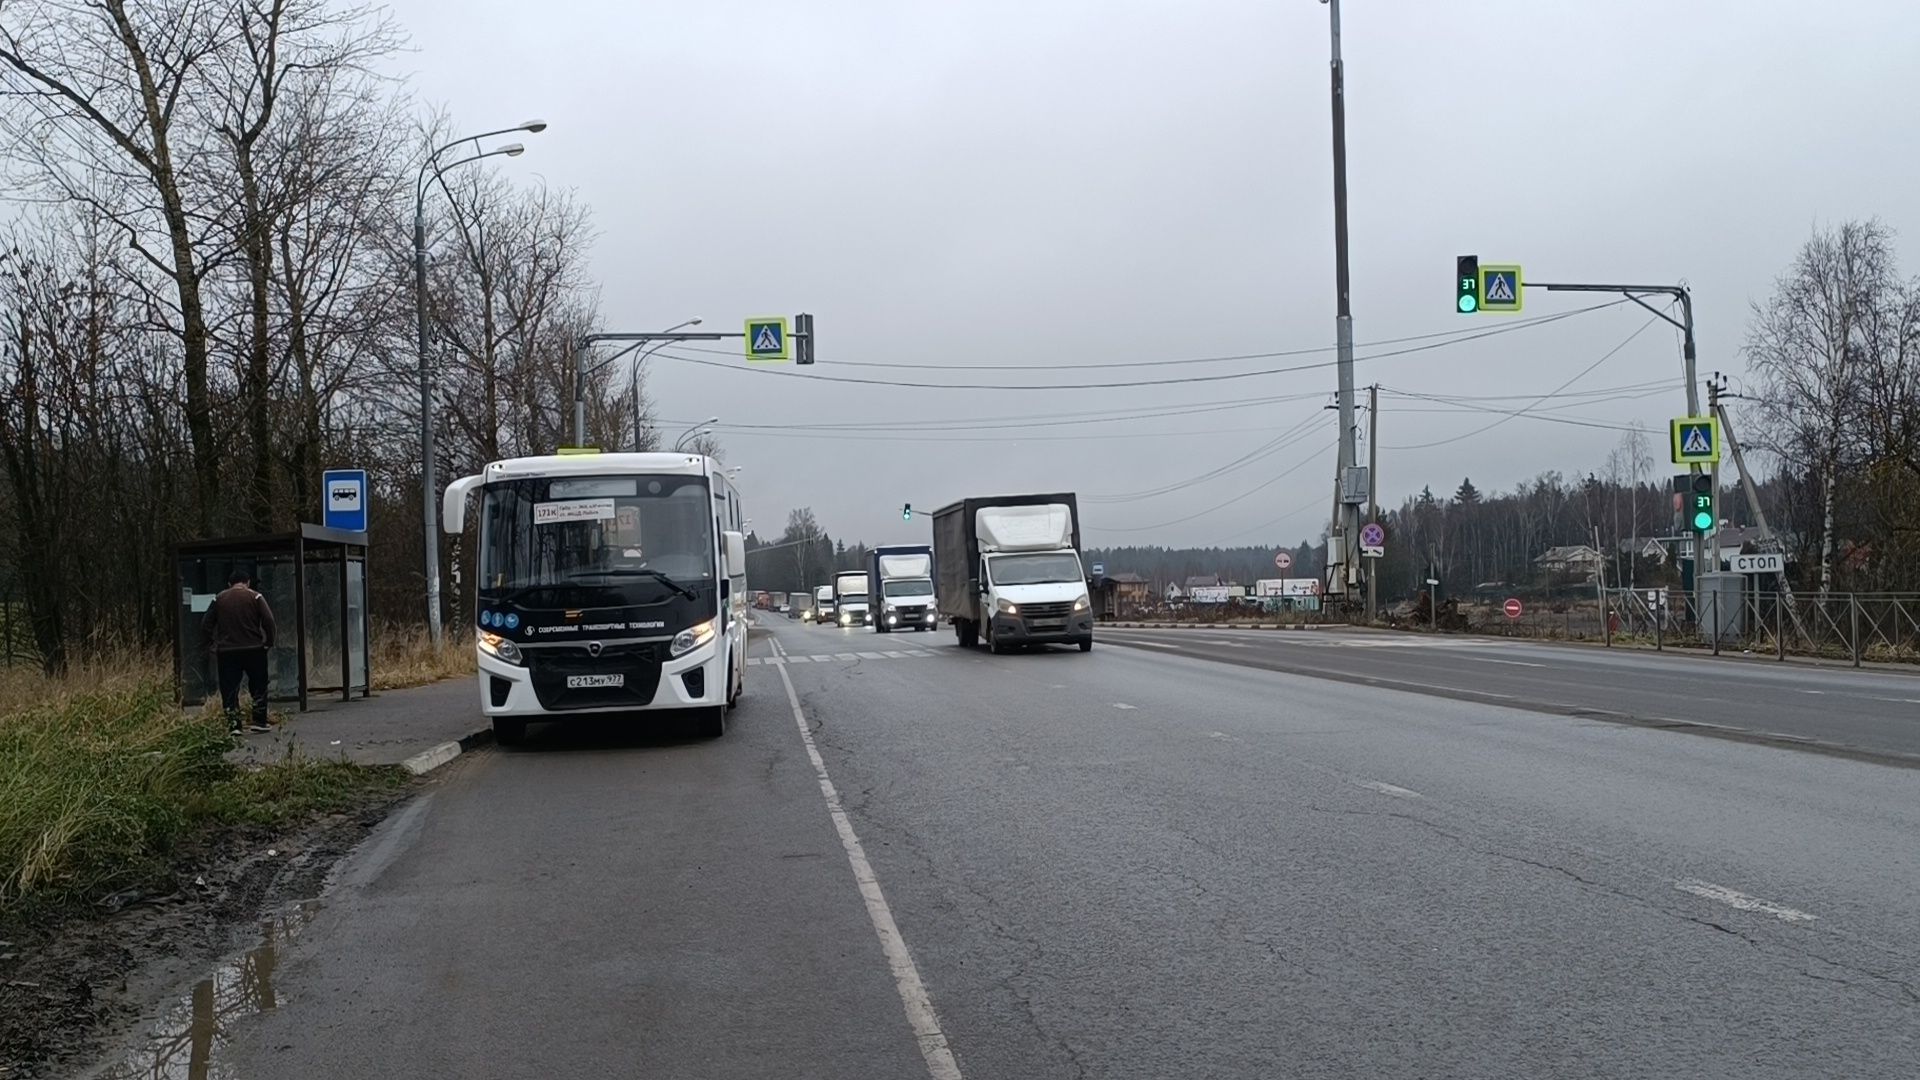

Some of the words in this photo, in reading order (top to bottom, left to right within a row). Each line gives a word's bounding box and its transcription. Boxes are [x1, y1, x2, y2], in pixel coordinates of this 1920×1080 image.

[1462, 278, 1476, 290] 37
[1697, 496, 1711, 507] 37
[1738, 557, 1777, 570] СТОП
